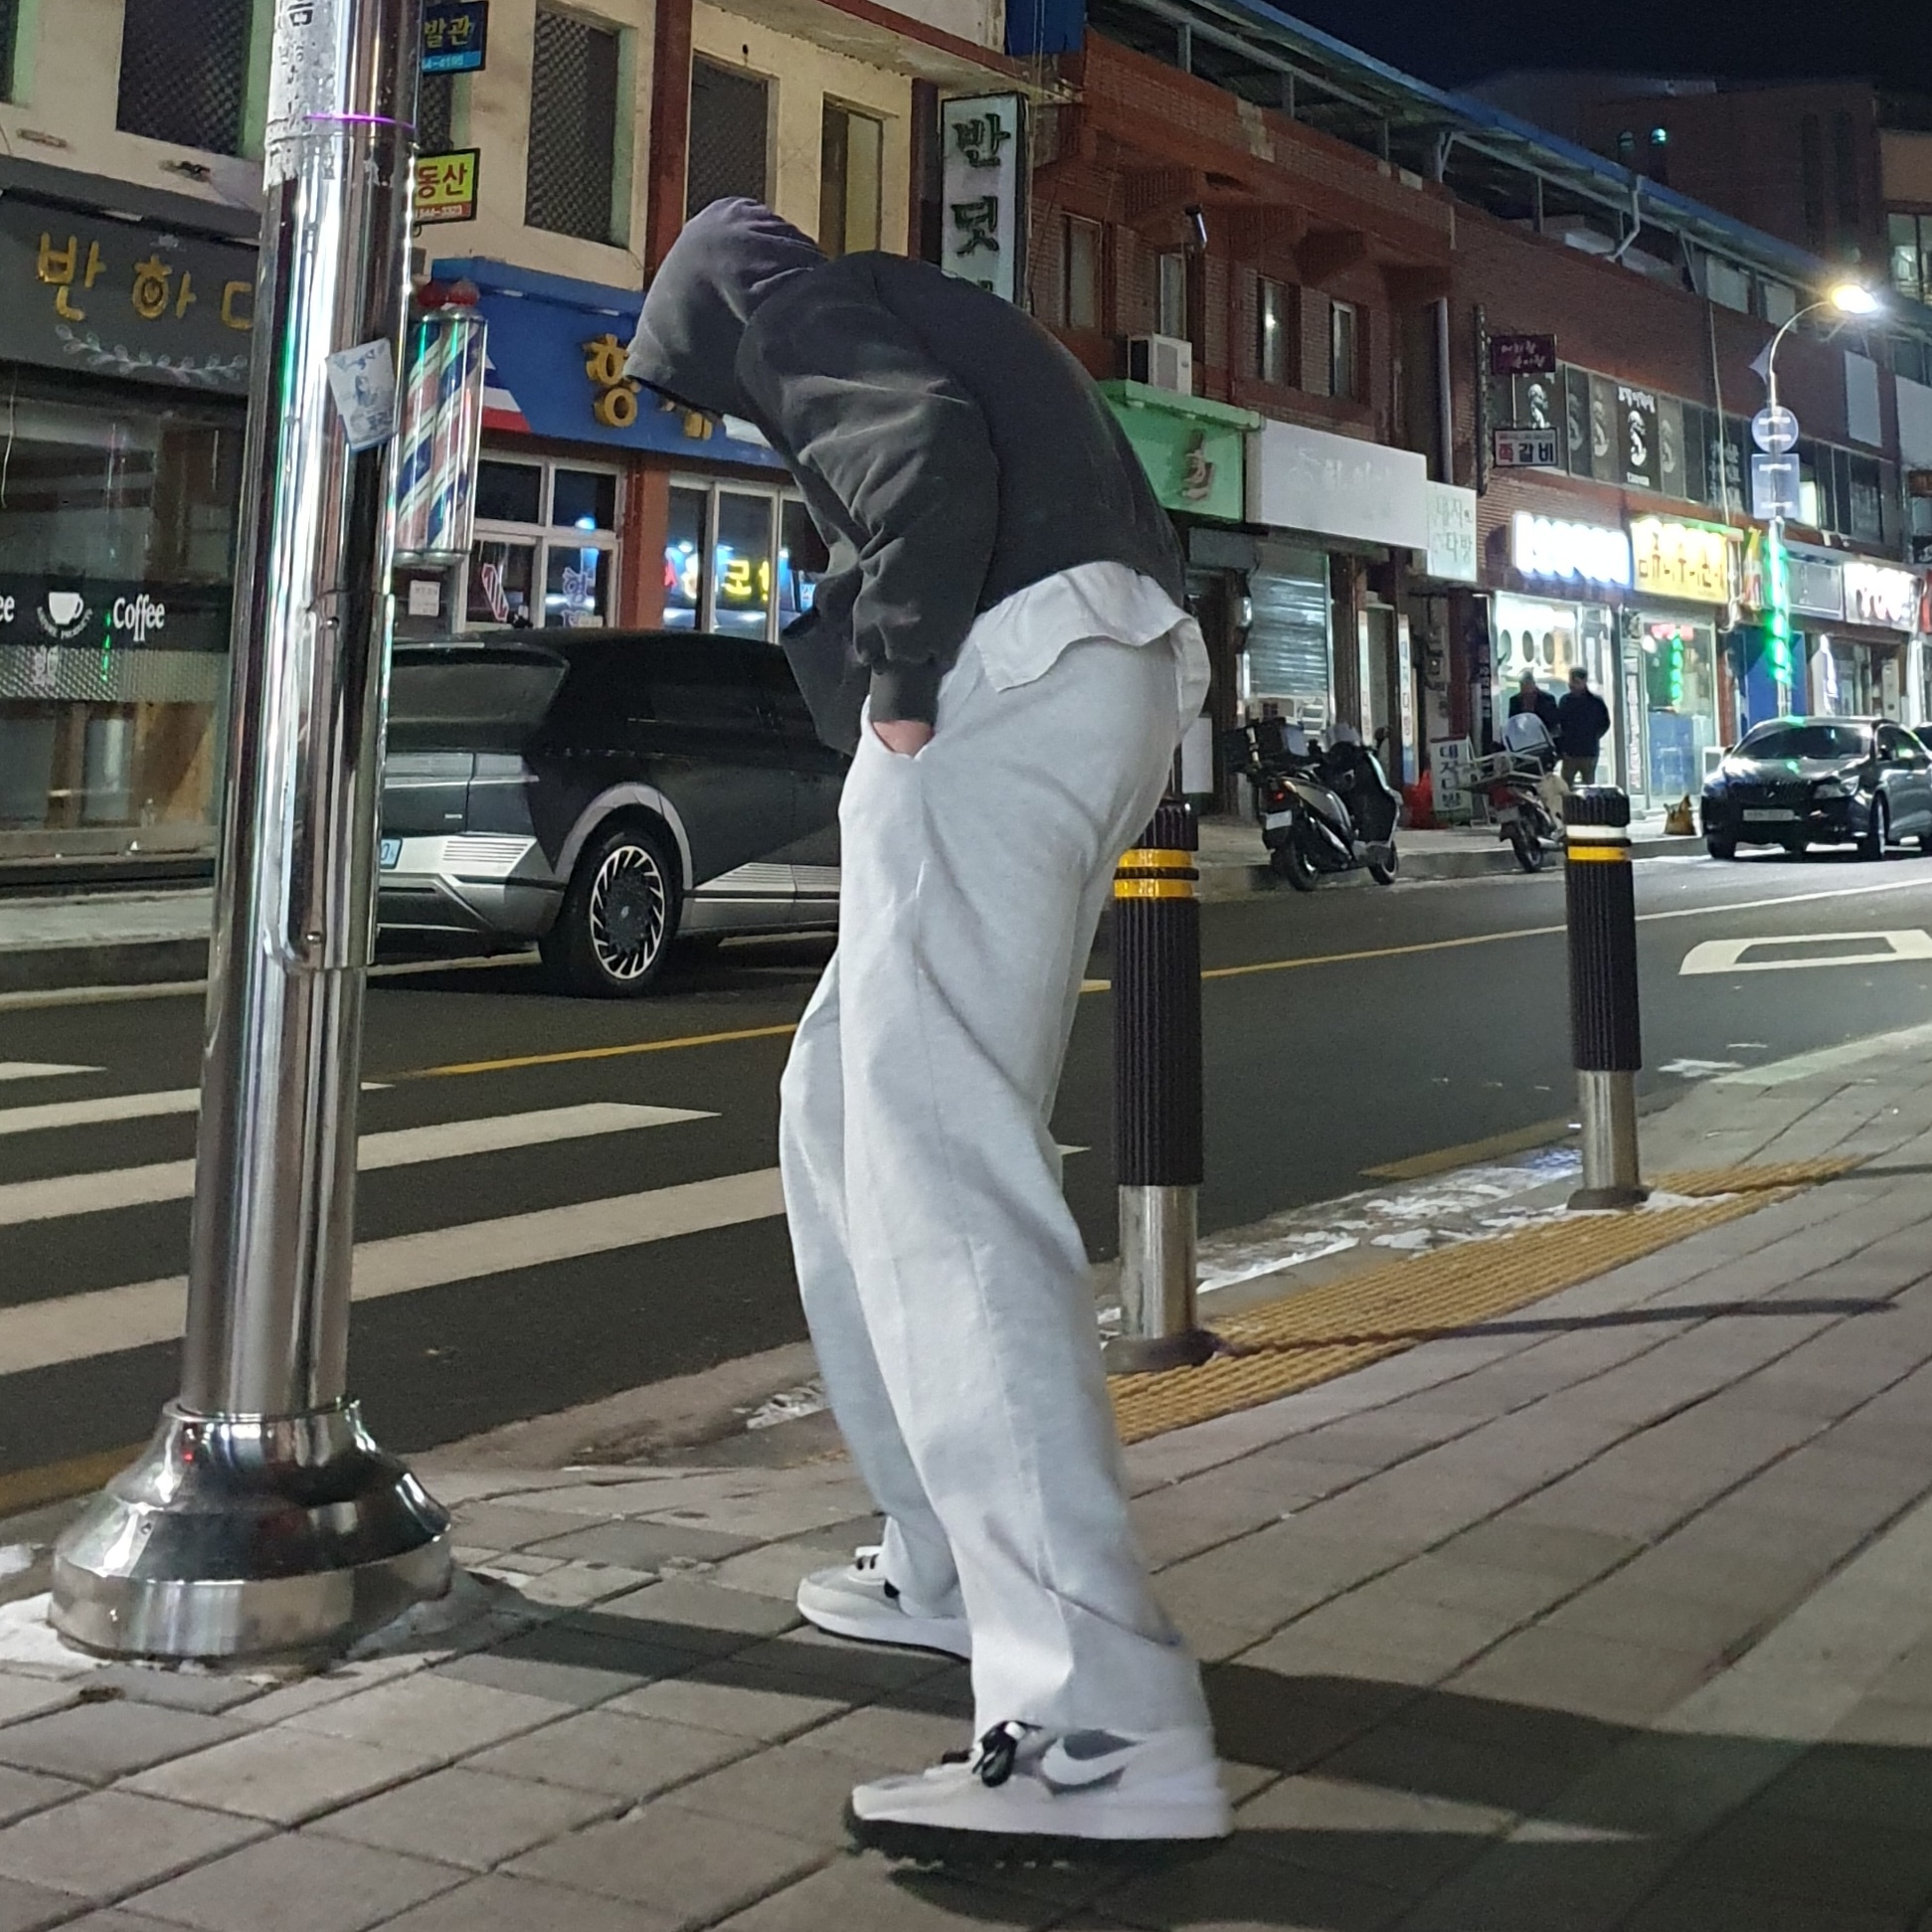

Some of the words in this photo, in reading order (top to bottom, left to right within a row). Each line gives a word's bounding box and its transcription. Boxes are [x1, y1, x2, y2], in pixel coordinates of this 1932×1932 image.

[419, 162, 467, 199] 동산
[952, 112, 1011, 292] 반딧
[113, 594, 165, 641] Coffee
